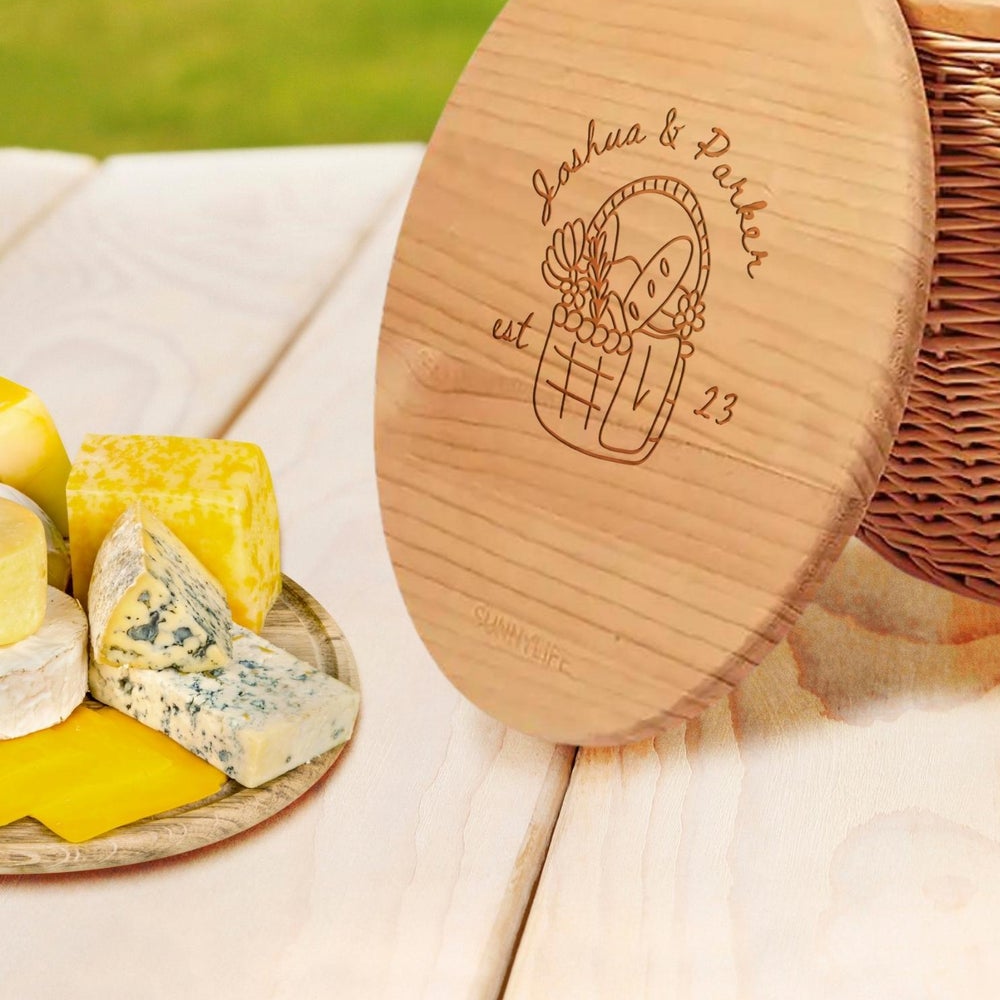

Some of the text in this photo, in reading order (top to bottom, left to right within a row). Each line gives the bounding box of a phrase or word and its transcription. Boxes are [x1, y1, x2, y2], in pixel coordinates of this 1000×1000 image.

[532, 107, 768, 279] Joshua & Parker
[492, 312, 535, 349] est
[693, 386, 739, 425] 23
